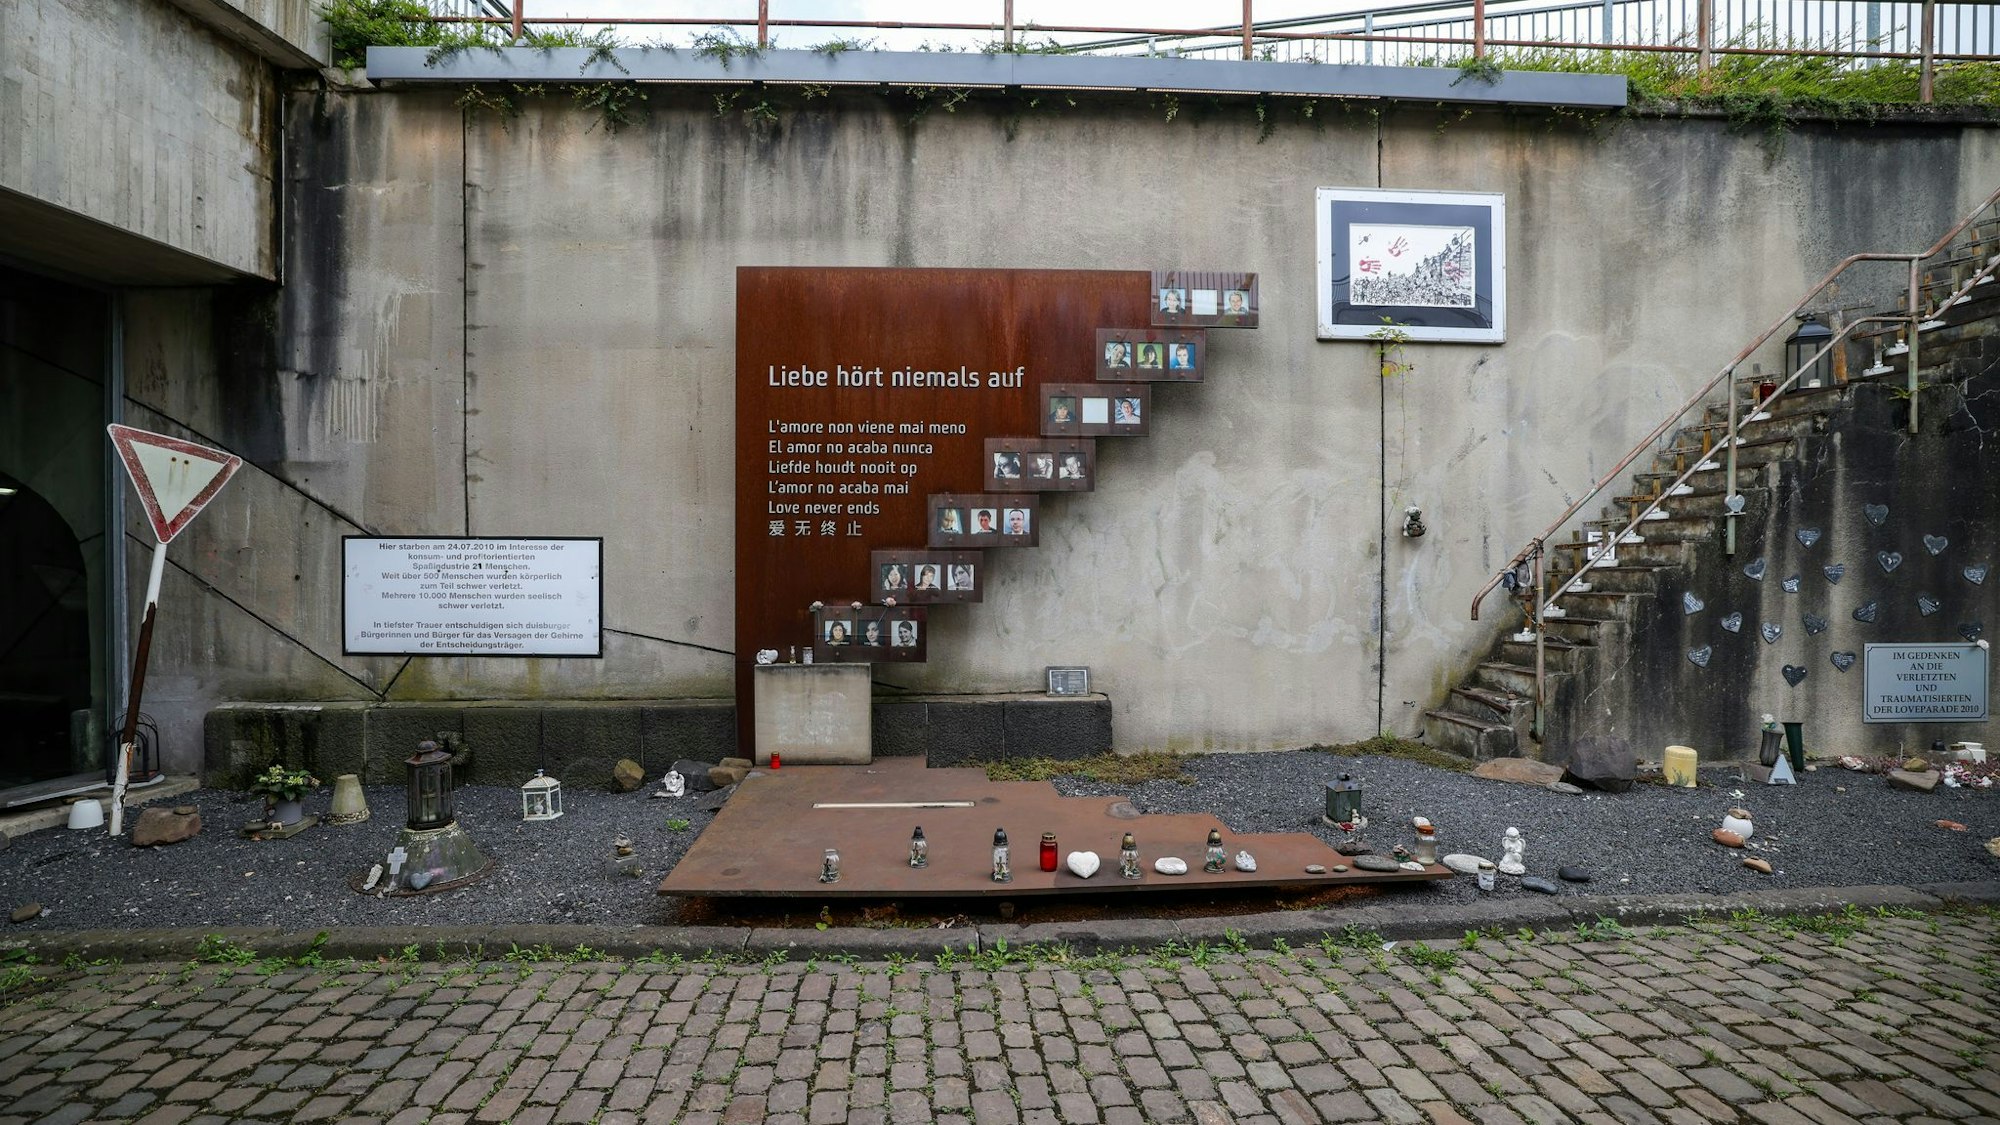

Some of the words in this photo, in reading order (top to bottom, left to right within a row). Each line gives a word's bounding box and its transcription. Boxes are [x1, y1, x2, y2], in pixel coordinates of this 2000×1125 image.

[769, 365, 828, 387] Liebe
[837, 365, 884, 387] hört
[892, 365, 980, 387] niemals
[988, 365, 1024, 387] auf
[769, 420, 823, 434] L'amore
[828, 423, 853, 434] non
[858, 421, 894, 434] viene
[900, 421, 923, 434] mai
[929, 423, 966, 434] meno
[769, 441, 782, 454] El
[787, 443, 821, 454] amor
[826, 443, 843, 454] no
[848, 441, 887, 454] acaba
[893, 443, 933, 454] nunca
[769, 461, 810, 473] Liefde
[816, 461, 855, 473] houdt
[861, 461, 896, 473] nooit
[901, 464, 917, 477] op
[818, 483, 834, 494] no
[840, 481, 879, 494] acaba
[884, 481, 908, 494] mai
[769, 501, 800, 514] Love
[805, 503, 842, 514] never
[847, 501, 880, 514] ends
[520, 573, 562, 581] körperlich
[445, 622, 503, 630] entschuldigen
[361, 631, 411, 639] Bürgerinnen
[433, 631, 460, 639] Bürger
[494, 631, 531, 639] Versagen
